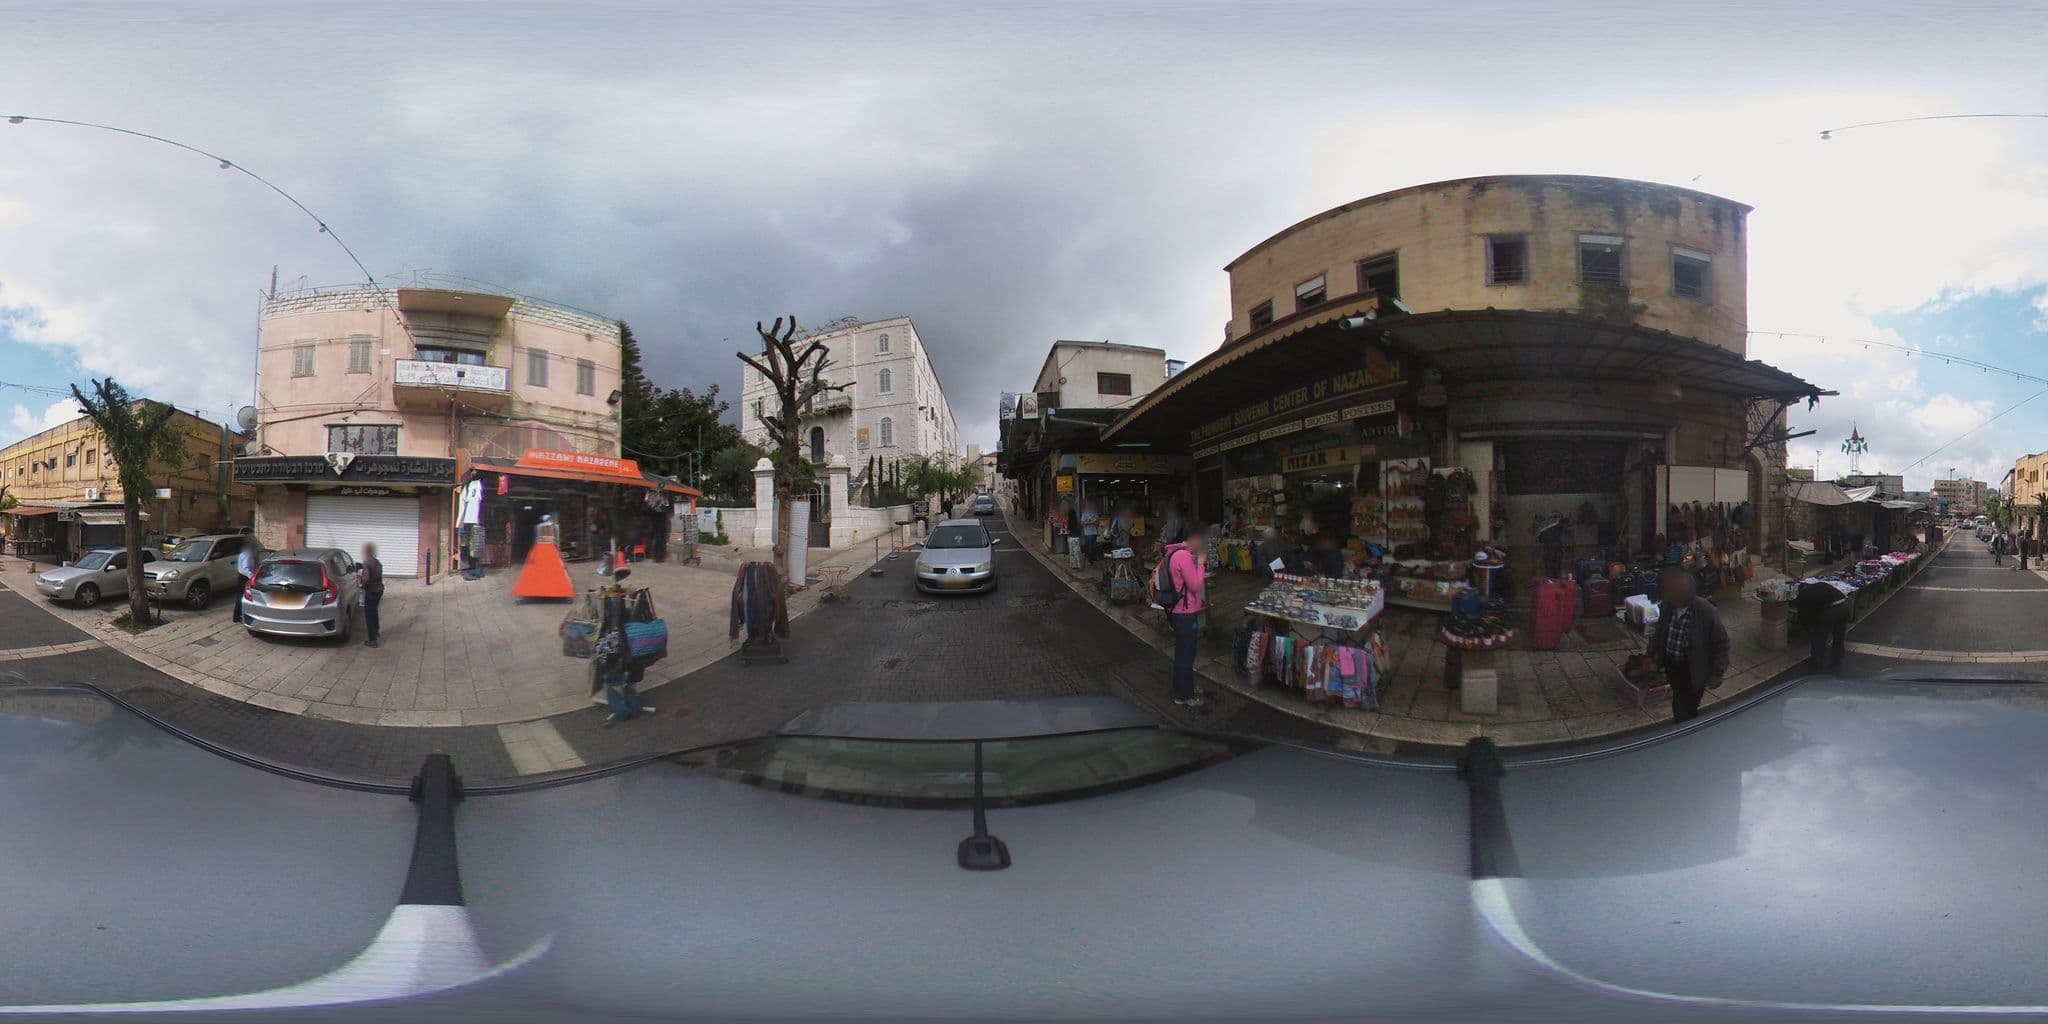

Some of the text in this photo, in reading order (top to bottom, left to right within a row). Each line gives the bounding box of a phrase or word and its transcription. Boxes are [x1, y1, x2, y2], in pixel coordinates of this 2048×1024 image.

[1273, 386, 1308, 411] CENTER
[1313, 378, 1329, 399] OF
[1332, 360, 1399, 393] NAZARH
[1343, 401, 1393, 418] POSTERS
[1307, 412, 1338, 426] BOOKS
[304, 461, 324, 473] מרכז
[576, 455, 619, 468] NAZARENE
